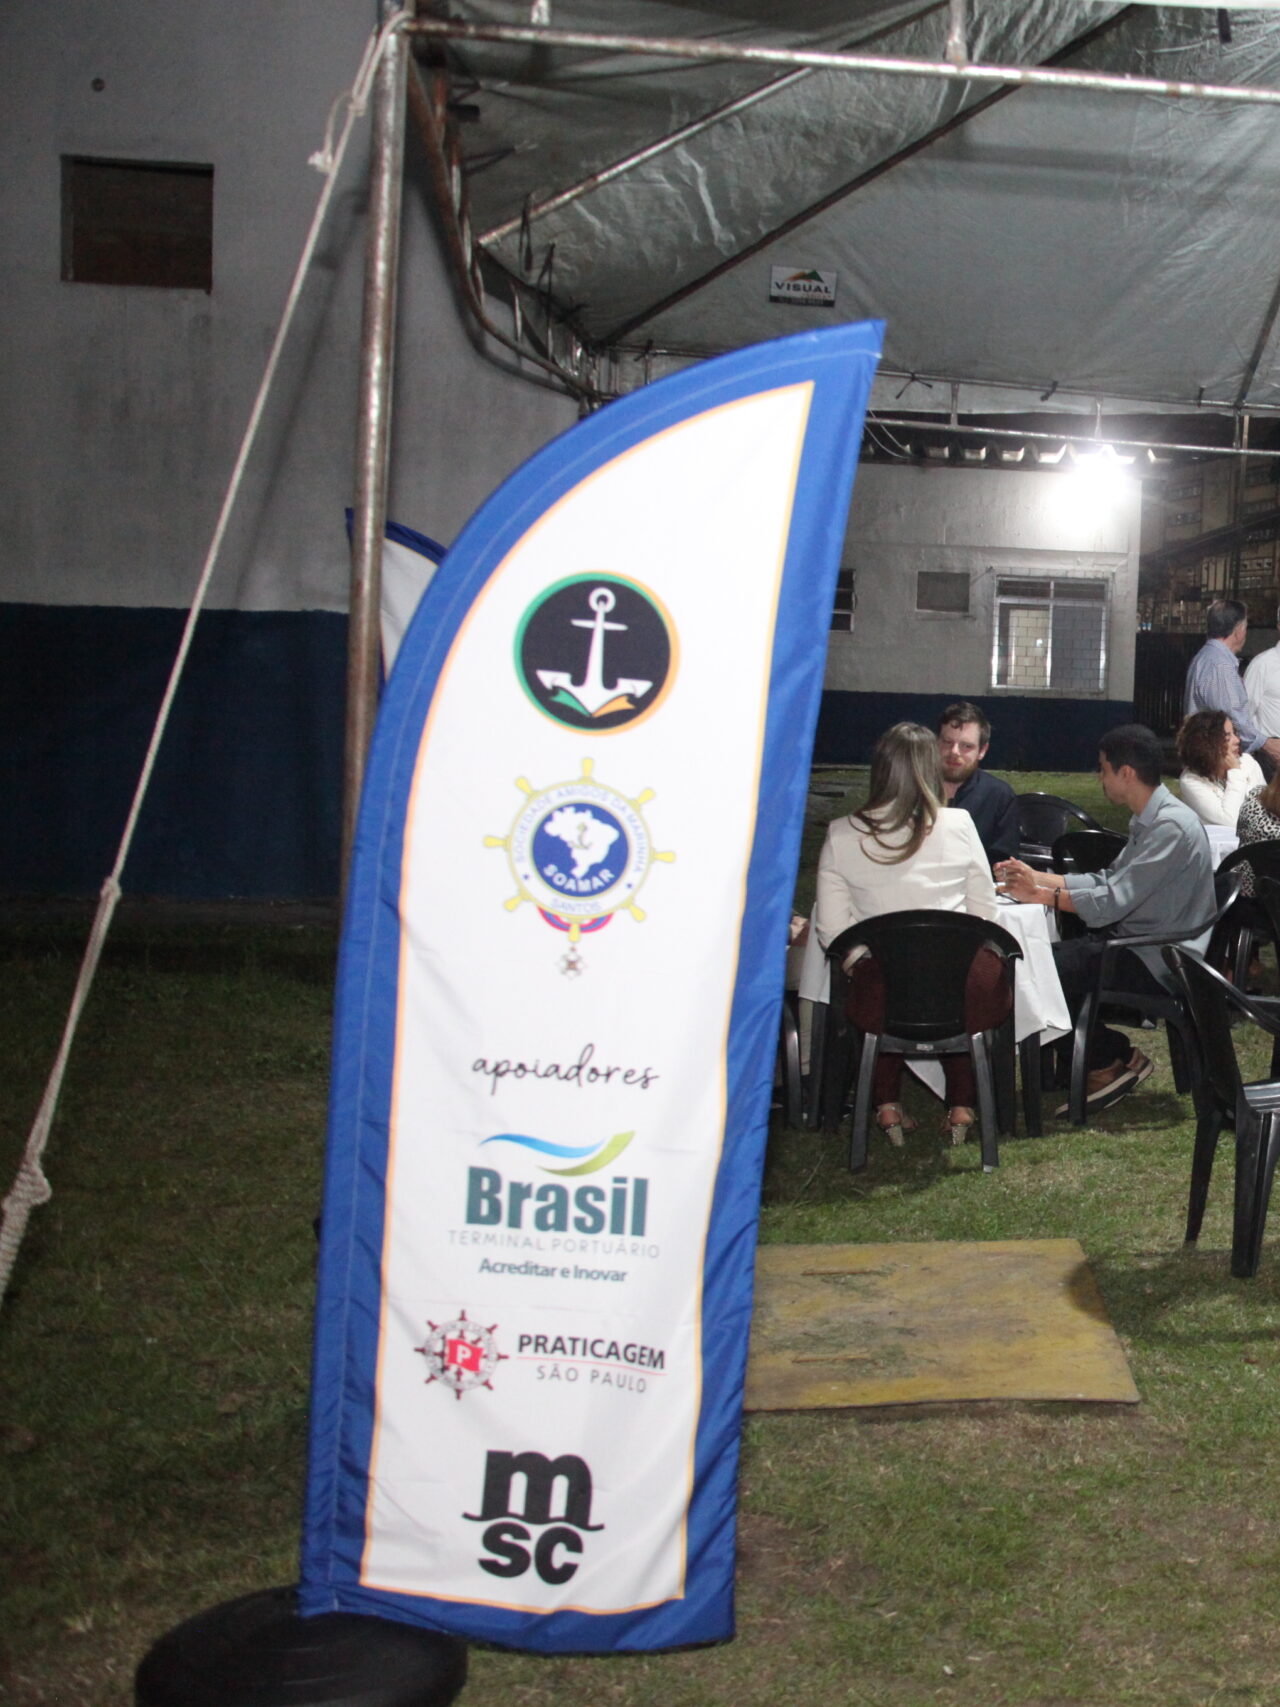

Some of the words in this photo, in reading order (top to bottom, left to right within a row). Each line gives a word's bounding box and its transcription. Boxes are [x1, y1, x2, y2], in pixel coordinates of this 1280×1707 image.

[775, 281, 832, 294] VISUAL
[556, 786, 609, 802] AMIGOS
[610, 797, 628, 813] DA
[625, 814, 648, 873] MARINHA
[543, 864, 615, 892] SOAMAR
[550, 897, 603, 914] SANTOS
[472, 1043, 660, 1096] apoiadores
[465, 1165, 649, 1237] Brasil
[448, 1230, 546, 1252] TERMINAL
[551, 1235, 661, 1260] PORTUÁRIO
[478, 1258, 557, 1279] Acreditar
[560, 1265, 571, 1279] e
[573, 1265, 629, 1282] Inovar
[456, 1344, 472, 1364] P
[518, 1334, 665, 1370] PRATICAGEM
[536, 1364, 580, 1383] SÃO
[590, 1368, 648, 1394] PAULO
